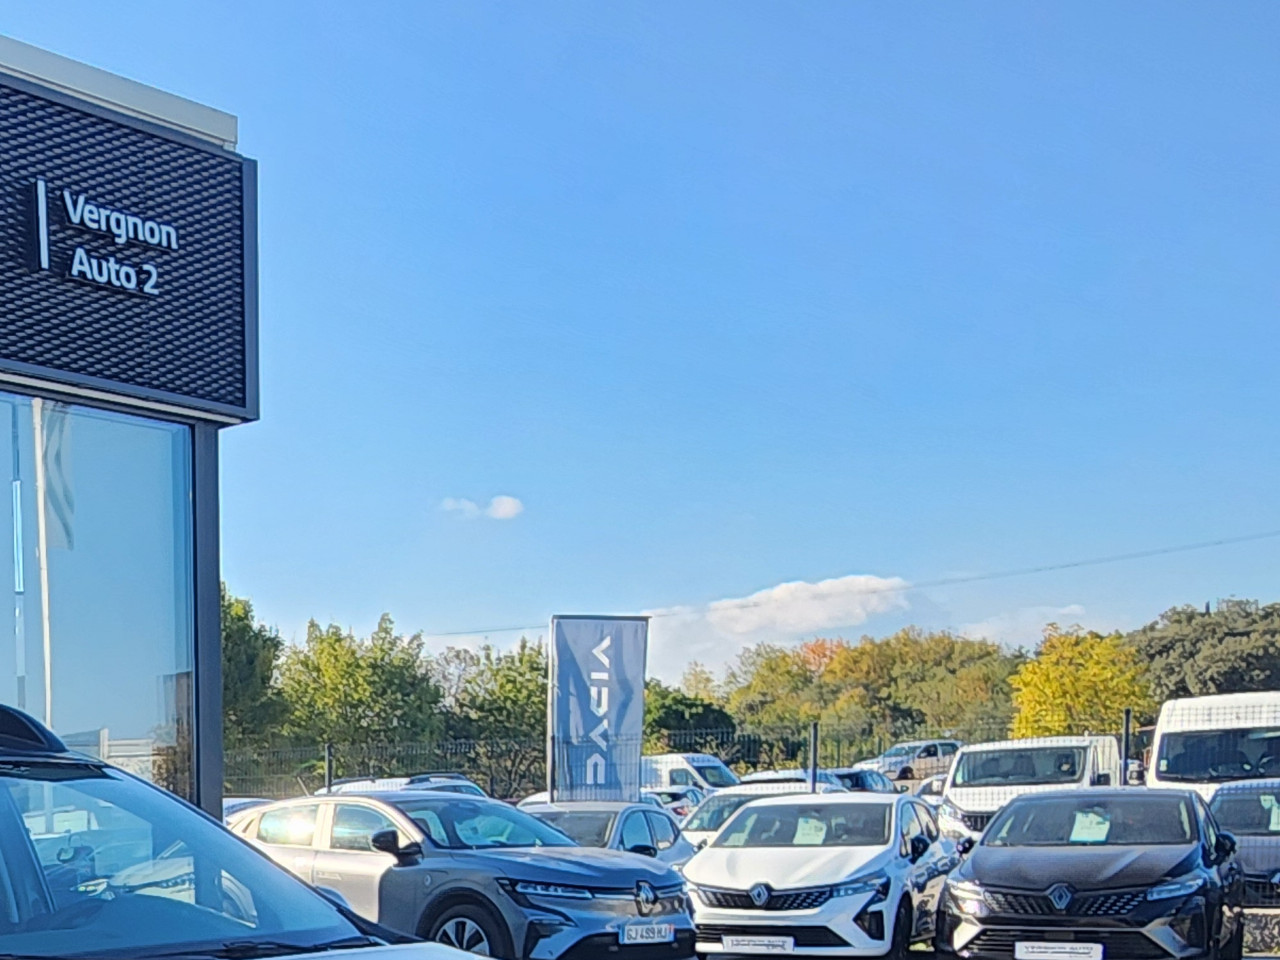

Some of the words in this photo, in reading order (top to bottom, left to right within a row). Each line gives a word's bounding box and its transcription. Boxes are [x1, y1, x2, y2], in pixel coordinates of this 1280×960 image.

[63, 189, 179, 250] Vergnon
[71, 247, 138, 289] Auto
[142, 264, 160, 295] 2
